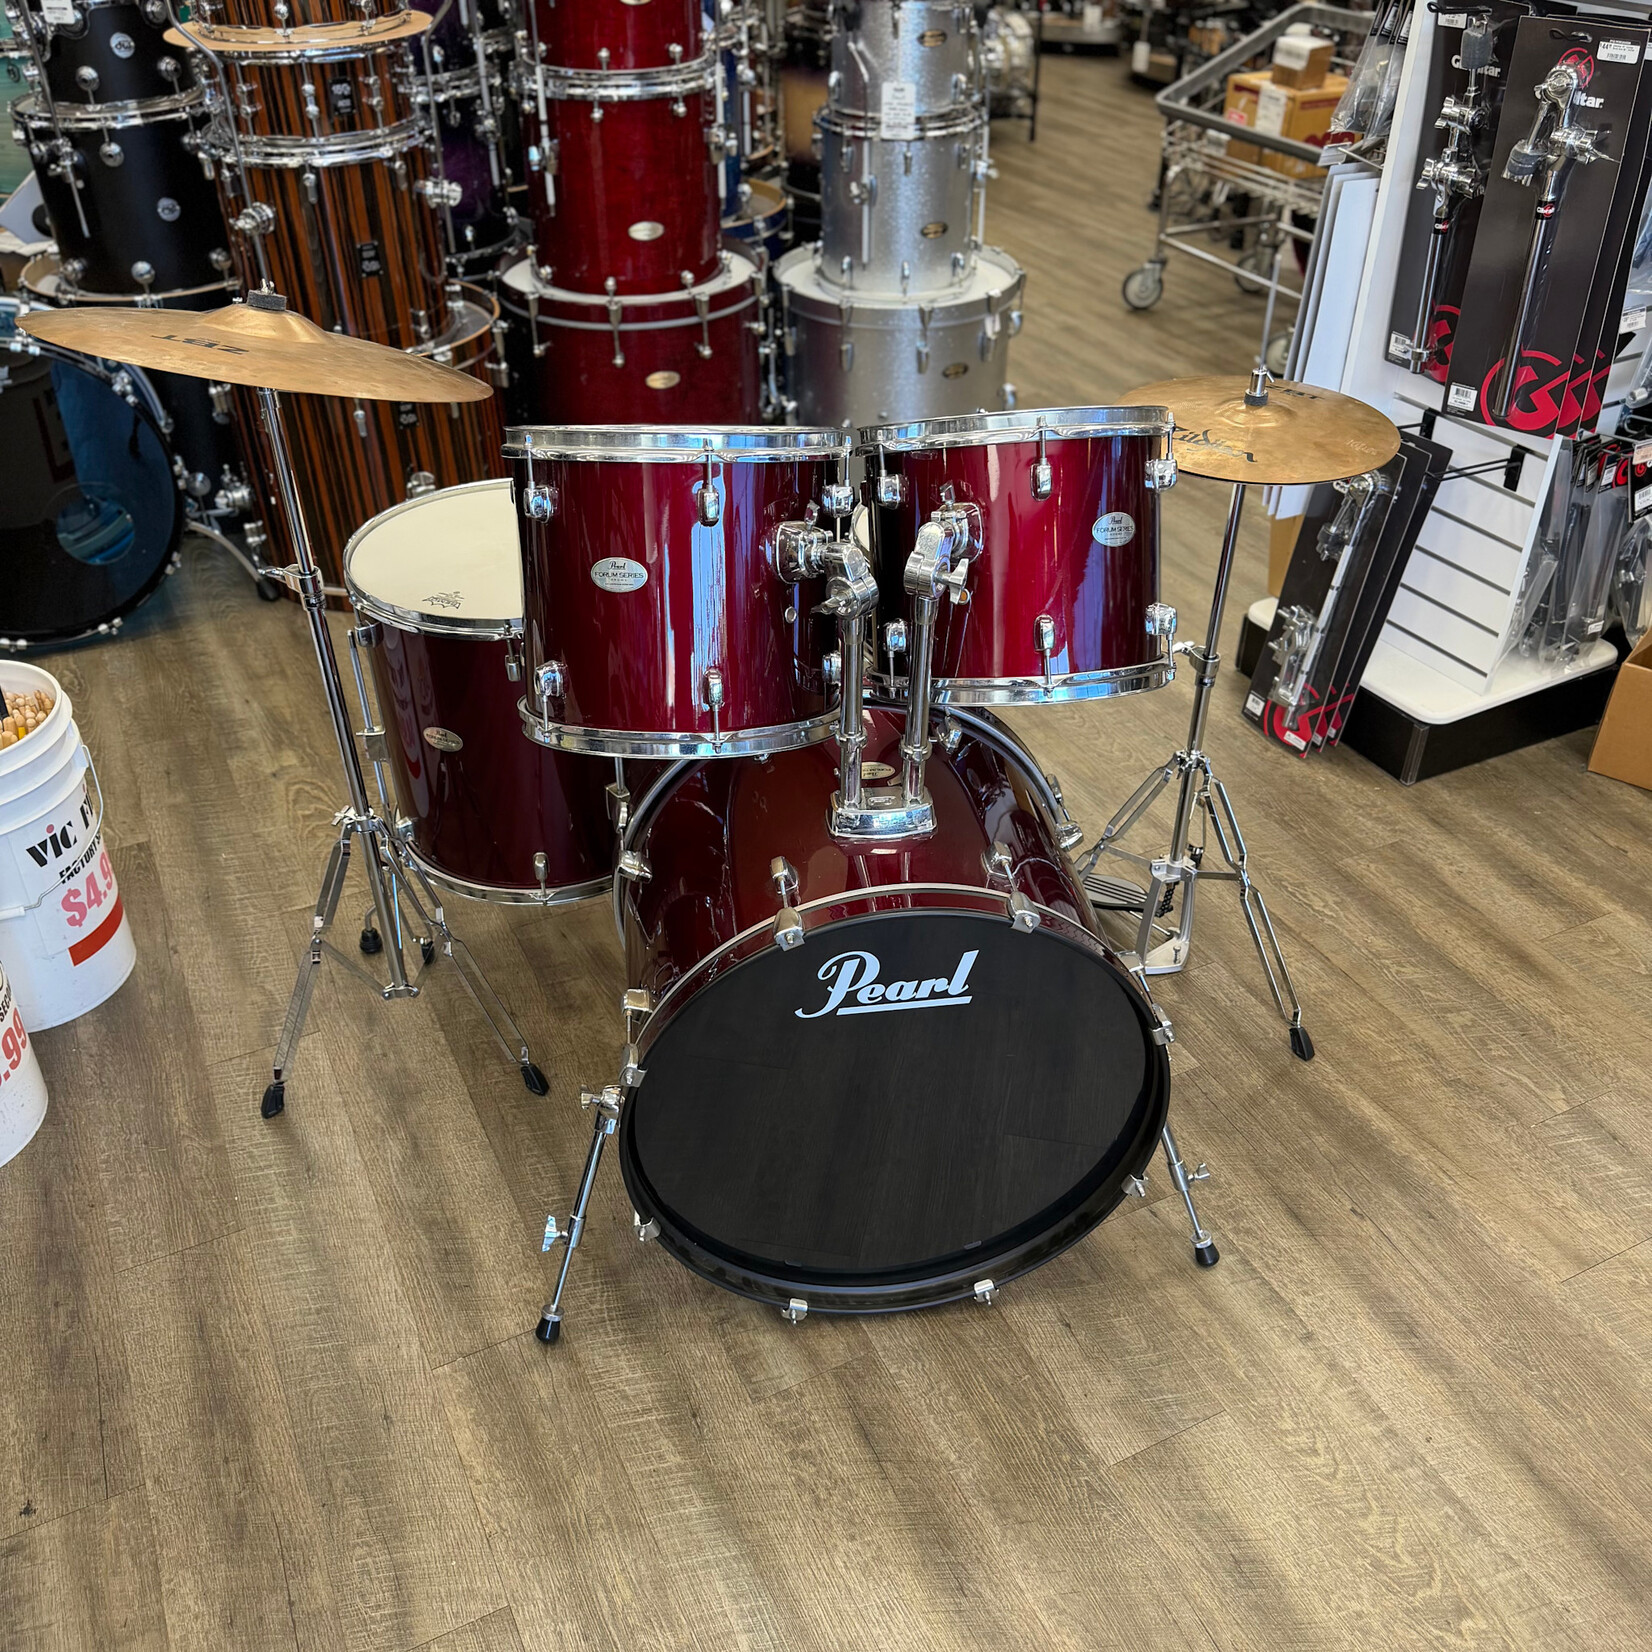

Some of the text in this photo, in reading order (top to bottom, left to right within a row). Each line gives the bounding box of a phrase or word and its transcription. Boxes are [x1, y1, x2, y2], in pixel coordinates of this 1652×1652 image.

[61, 852, 113, 928] $4.9
[794, 950, 980, 1019] Pearl
[0, 1007, 27, 1086] .99
